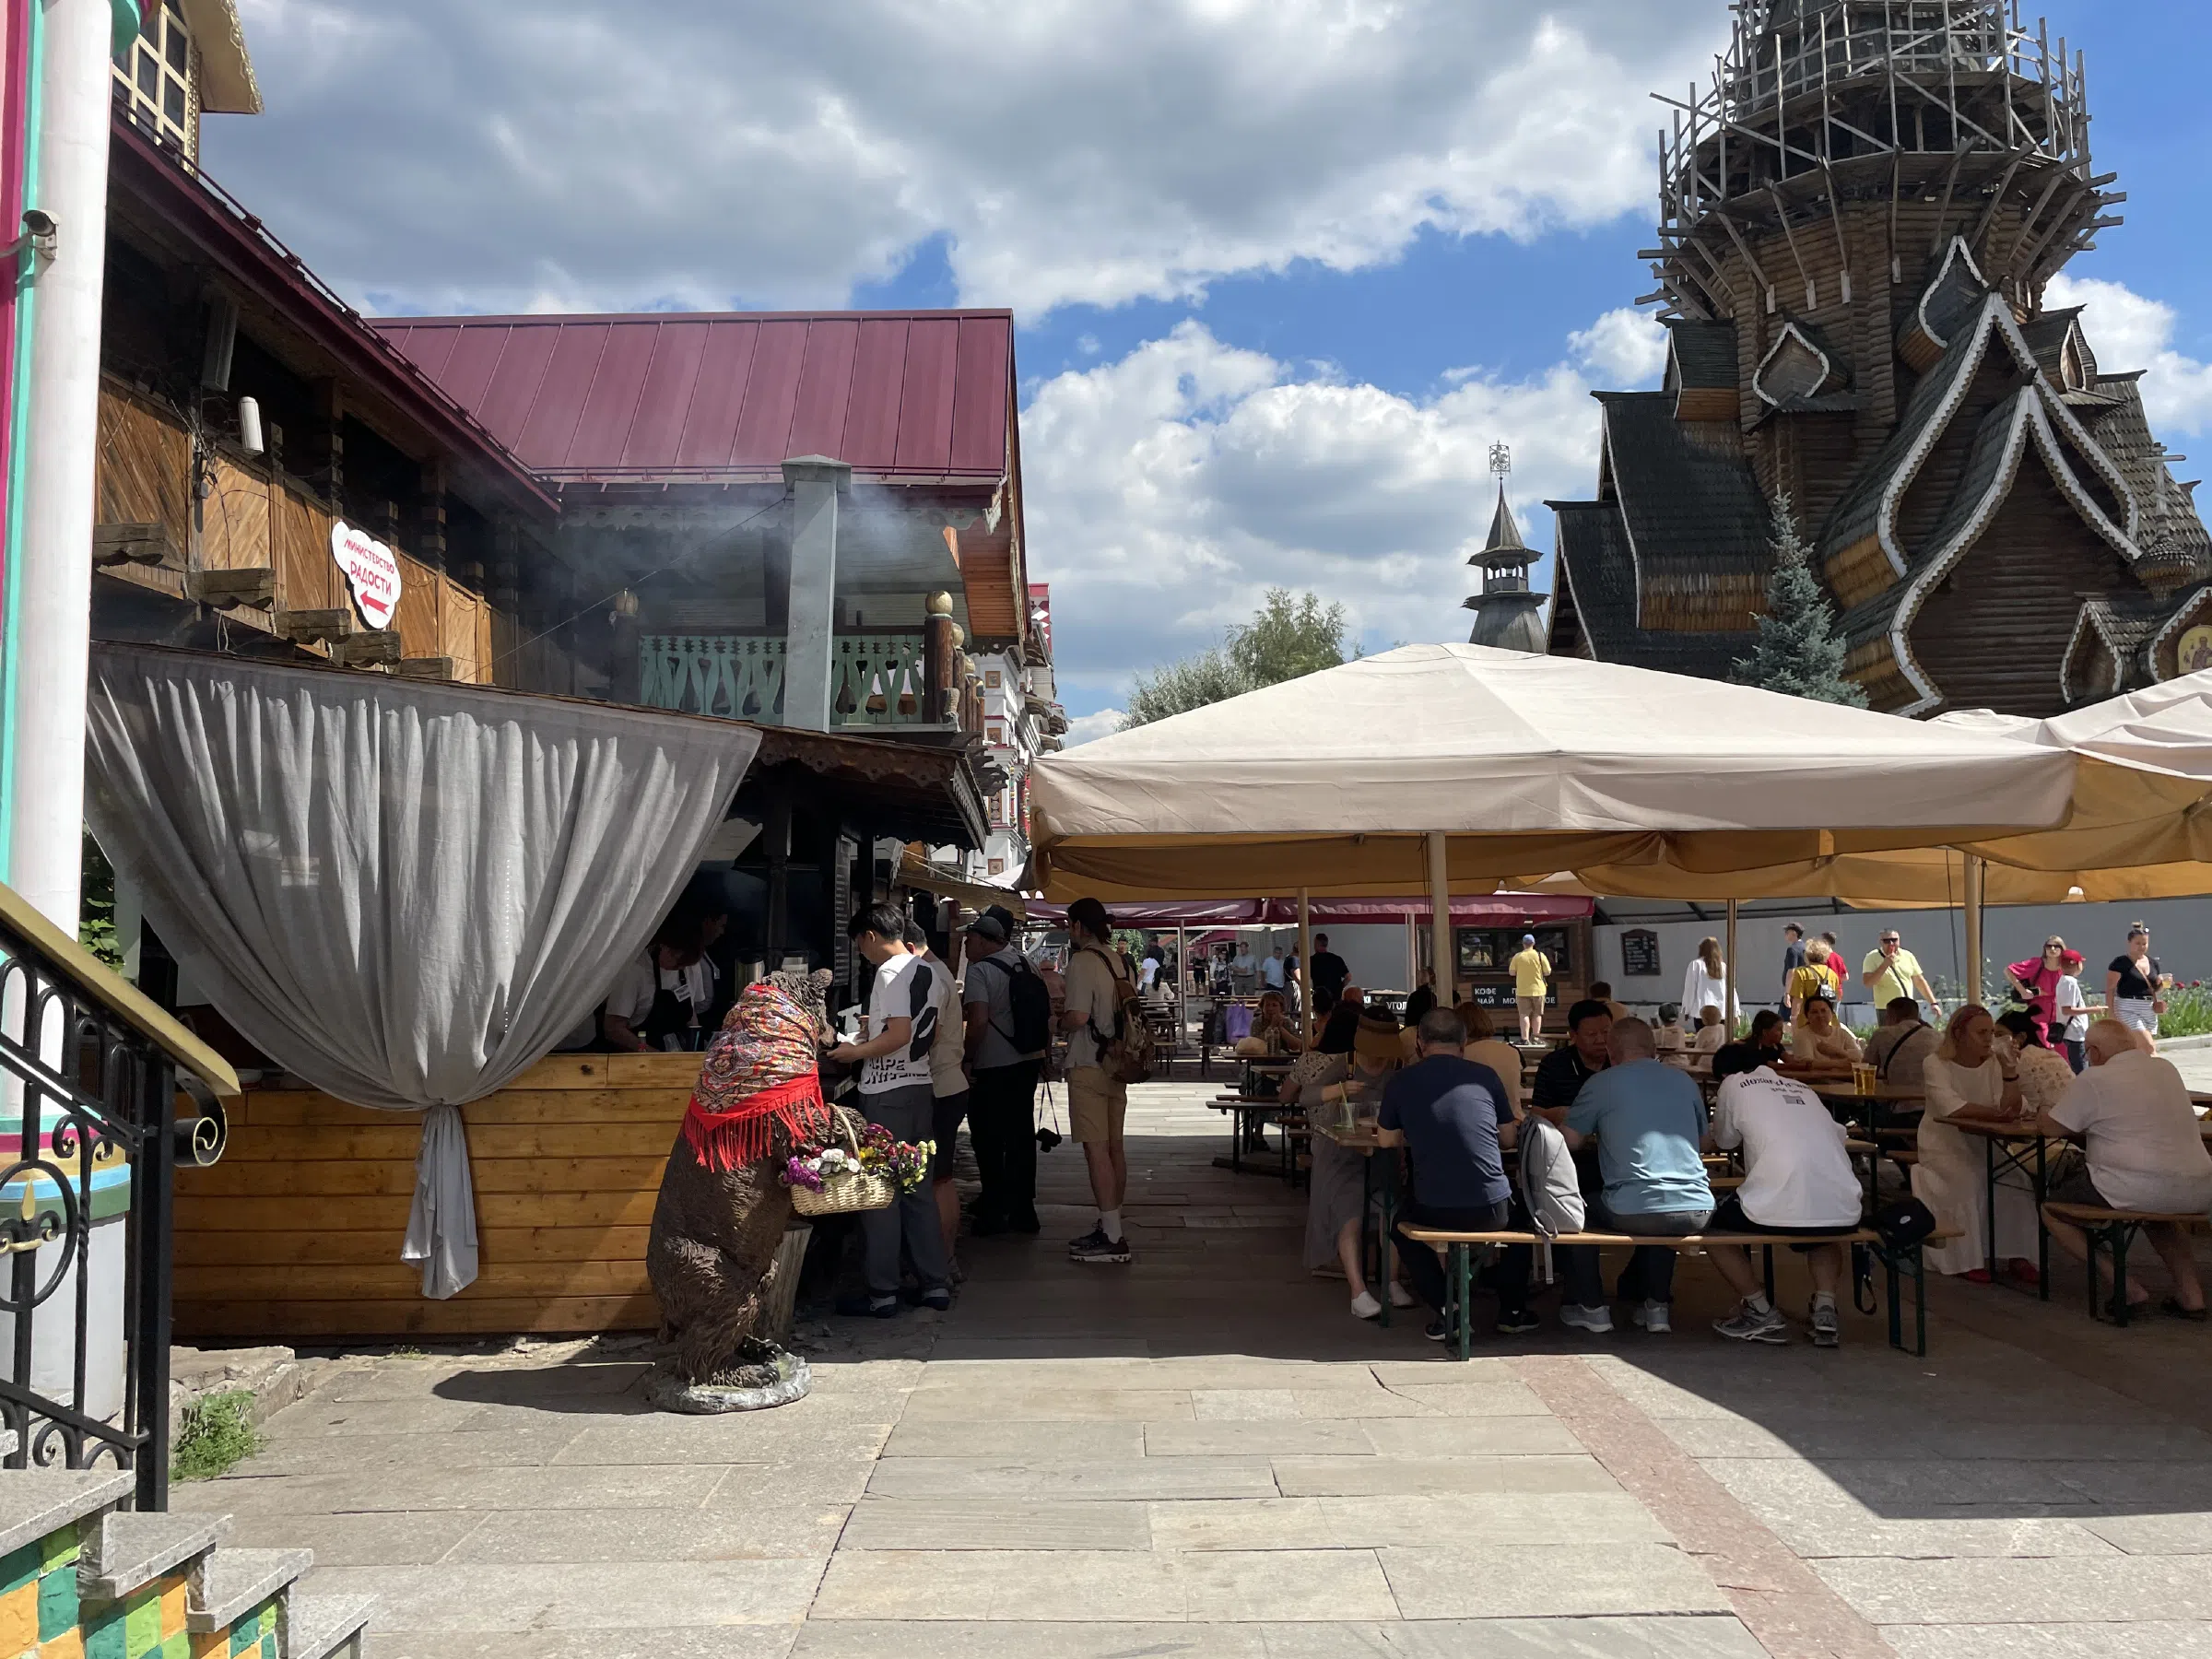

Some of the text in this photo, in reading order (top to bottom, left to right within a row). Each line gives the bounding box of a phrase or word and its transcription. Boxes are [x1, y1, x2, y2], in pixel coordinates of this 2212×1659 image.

[344, 538, 394, 574] МИНИСТЕРСТВО
[350, 560, 392, 596] РАДОСТИ
[1475, 987, 1497, 995] КОФЕ
[1477, 995, 1495, 1005] ЧАЙ
